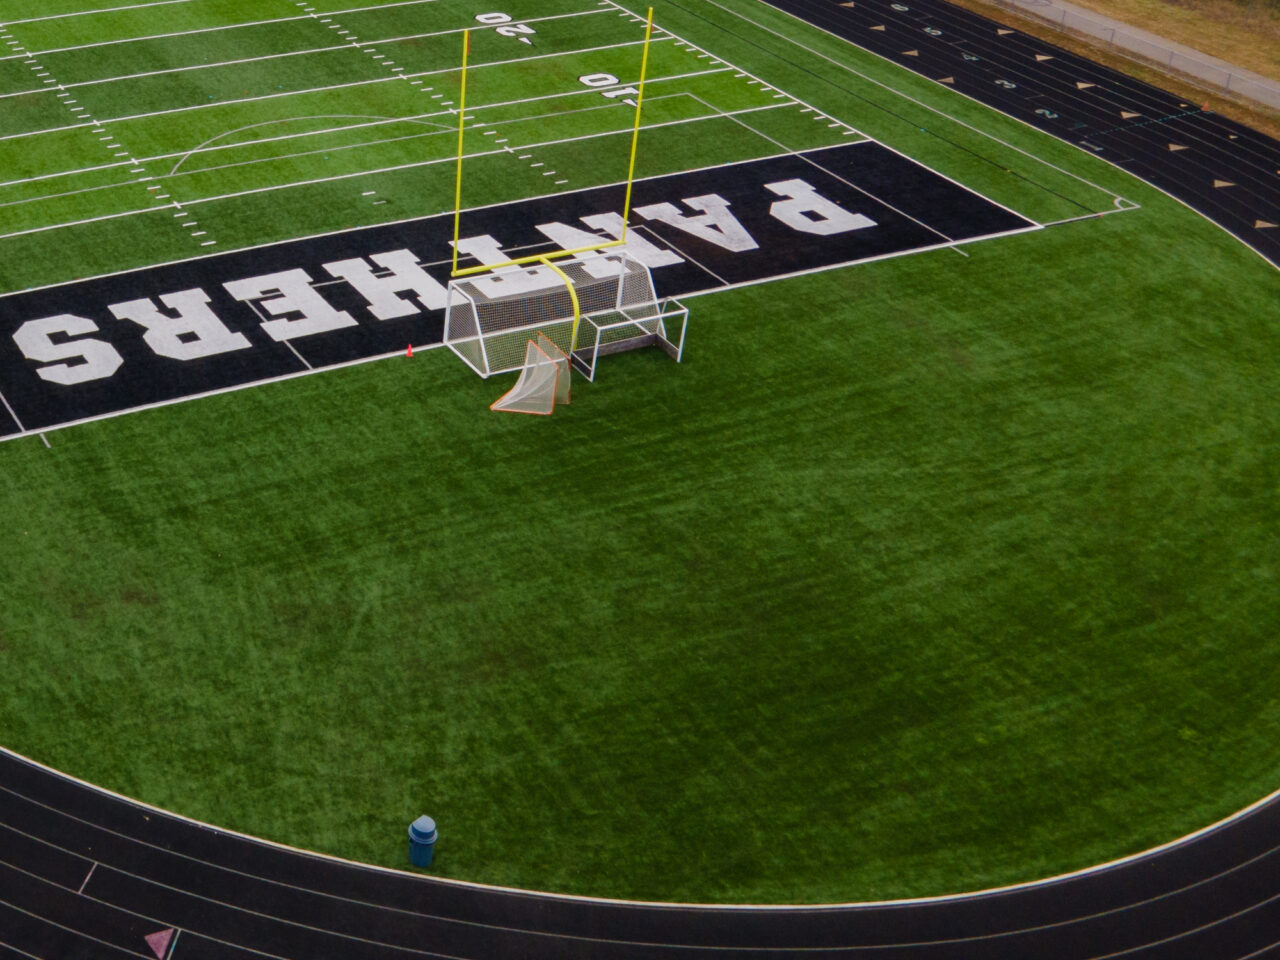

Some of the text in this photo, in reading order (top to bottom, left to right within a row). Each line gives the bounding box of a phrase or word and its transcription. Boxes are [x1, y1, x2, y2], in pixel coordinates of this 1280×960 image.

[474, 12, 538, 37] 20
[578, 72, 640, 99] 10
[1034, 108, 1059, 119] 2
[12, 178, 878, 386] PANTHERS
